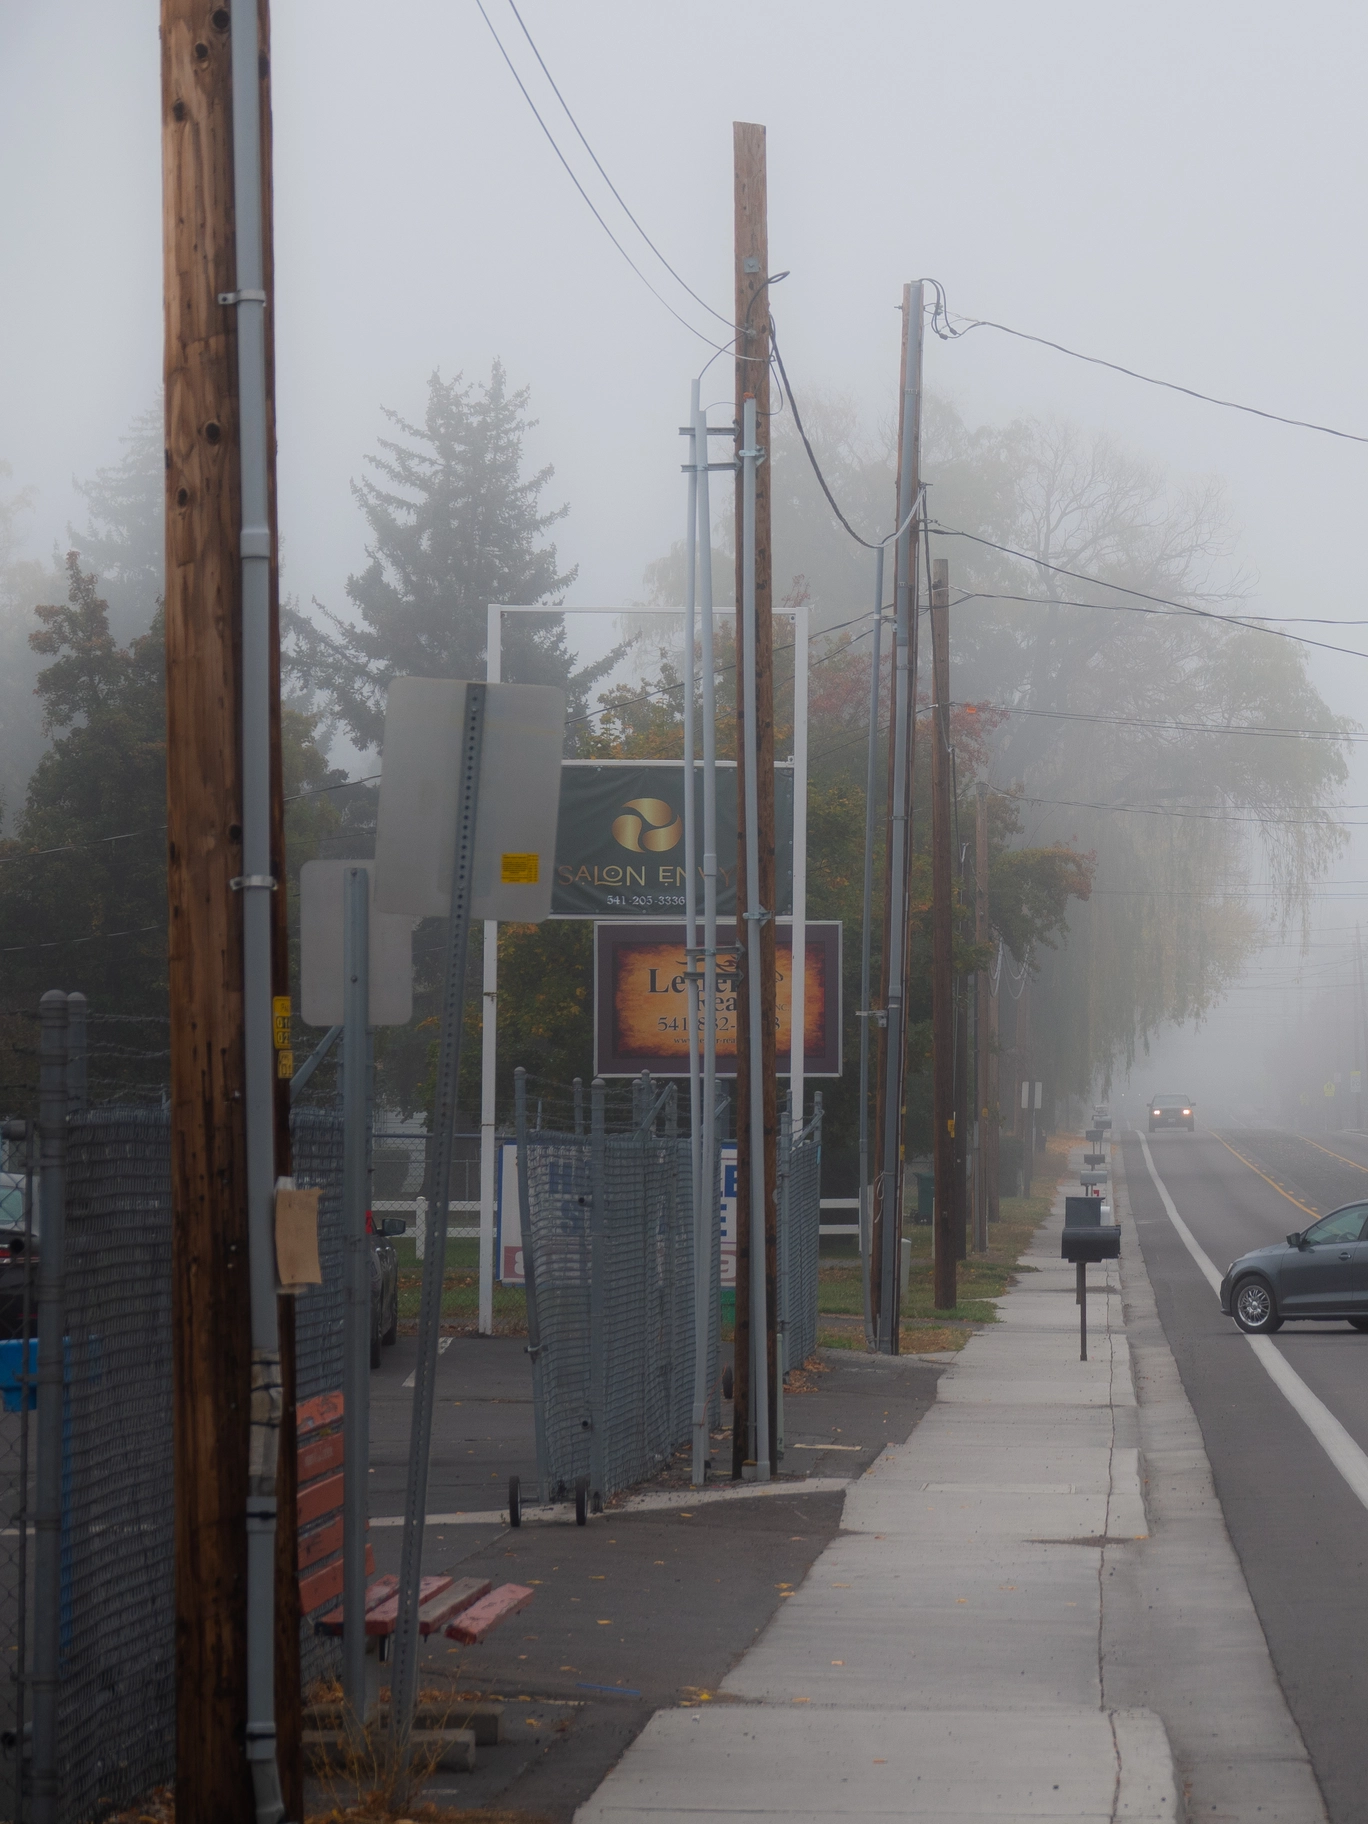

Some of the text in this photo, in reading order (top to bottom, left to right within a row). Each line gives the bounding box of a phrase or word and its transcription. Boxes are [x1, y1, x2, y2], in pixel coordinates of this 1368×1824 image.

[558, 865, 645, 887] SALON
[606, 895, 686, 906] 541-205-3336
[648, 968, 738, 993] Leer
